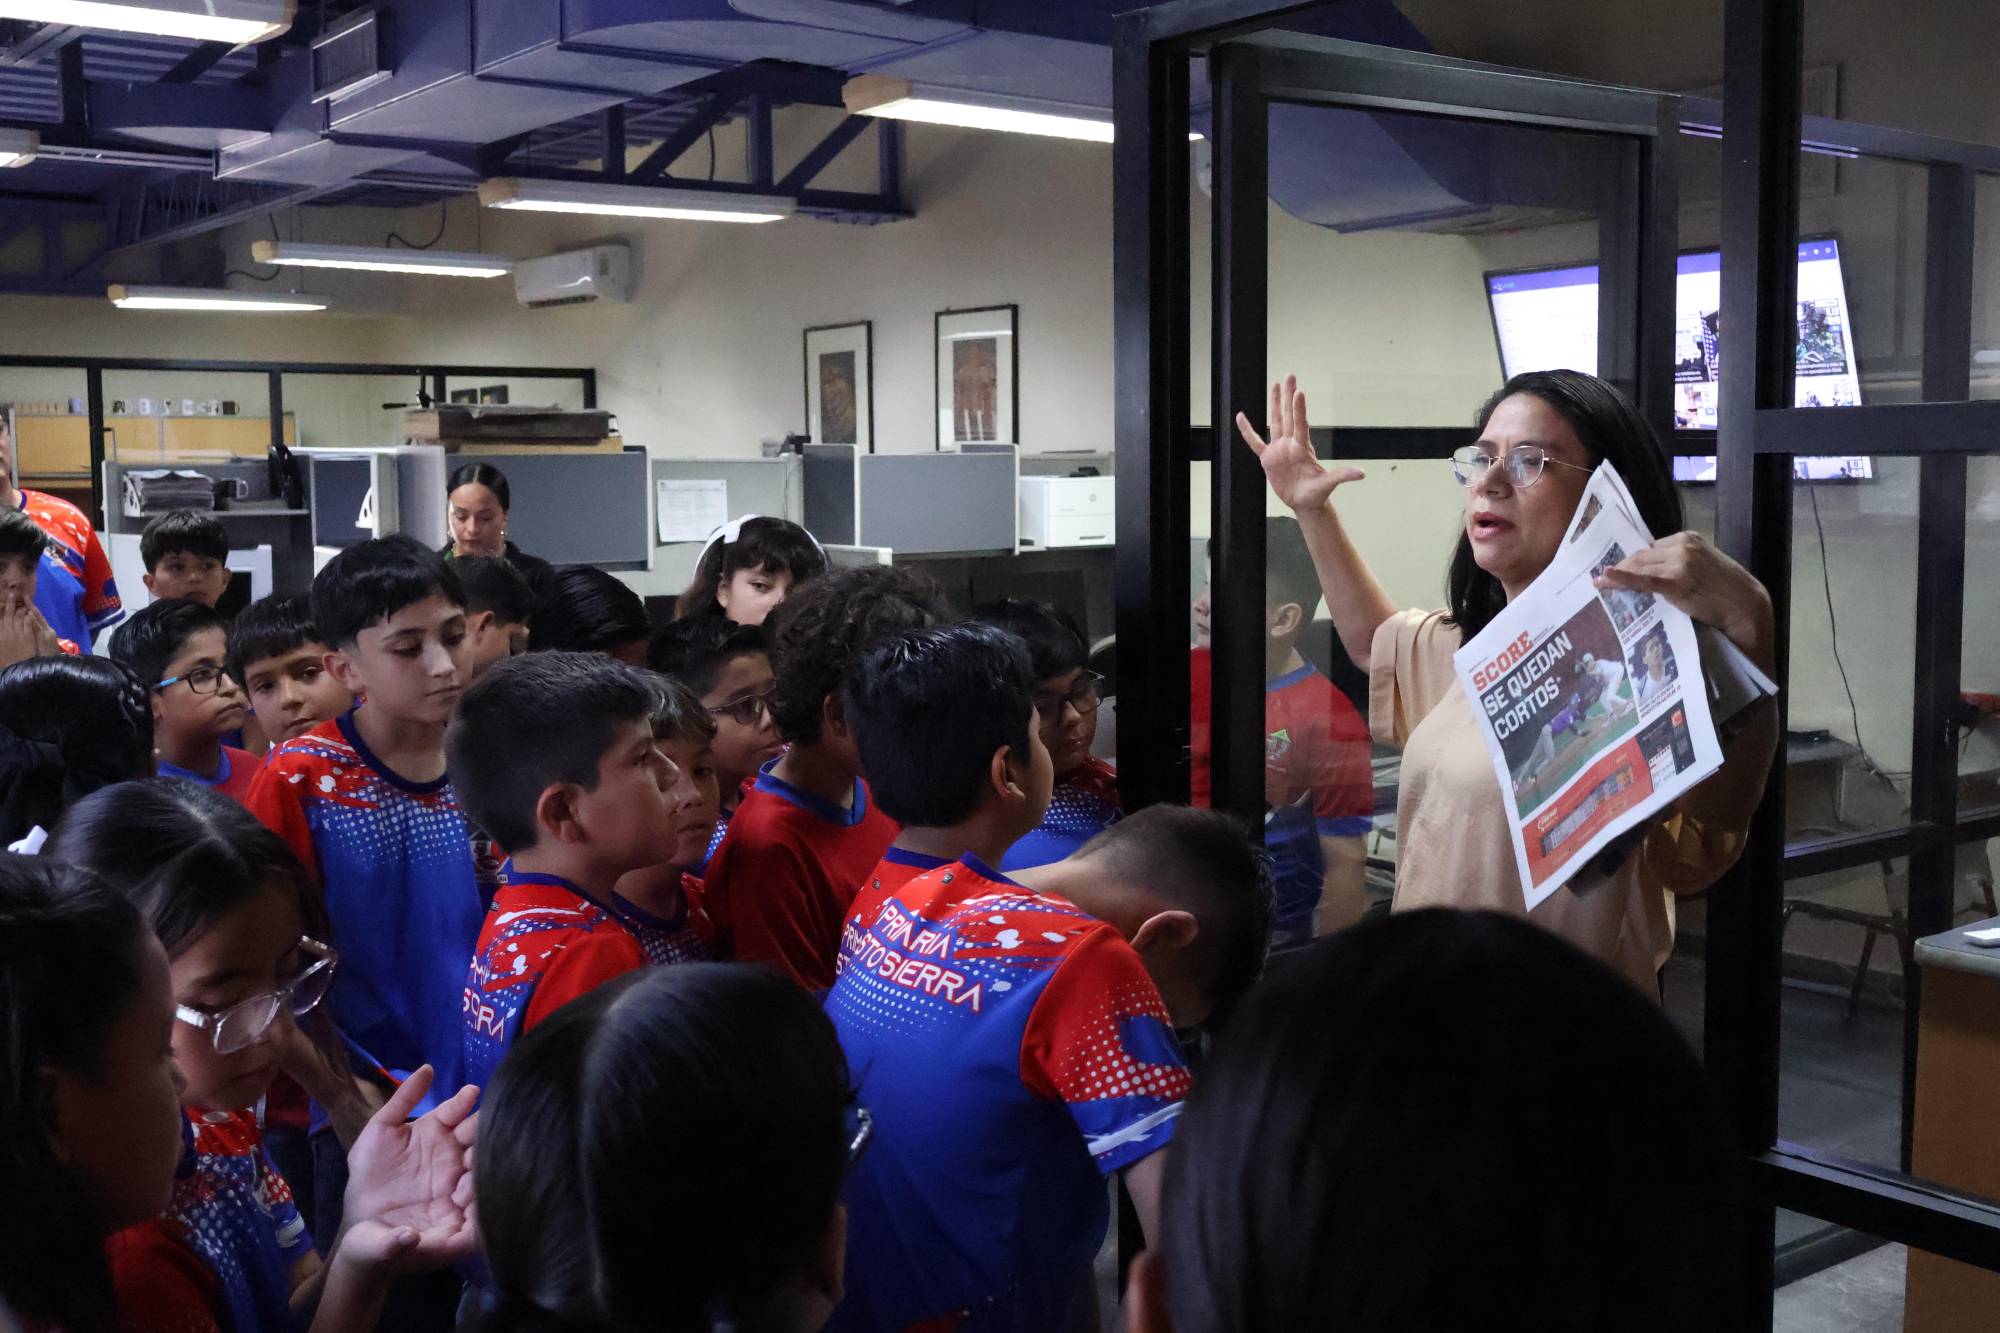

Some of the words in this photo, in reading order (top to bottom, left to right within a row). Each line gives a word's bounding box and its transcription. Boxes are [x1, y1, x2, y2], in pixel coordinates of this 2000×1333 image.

[1472, 630, 1534, 692] SCORE
[1483, 686, 1509, 717] SE
[1507, 630, 1573, 698] QUEDAN
[878, 950, 982, 1013] SIERRA
